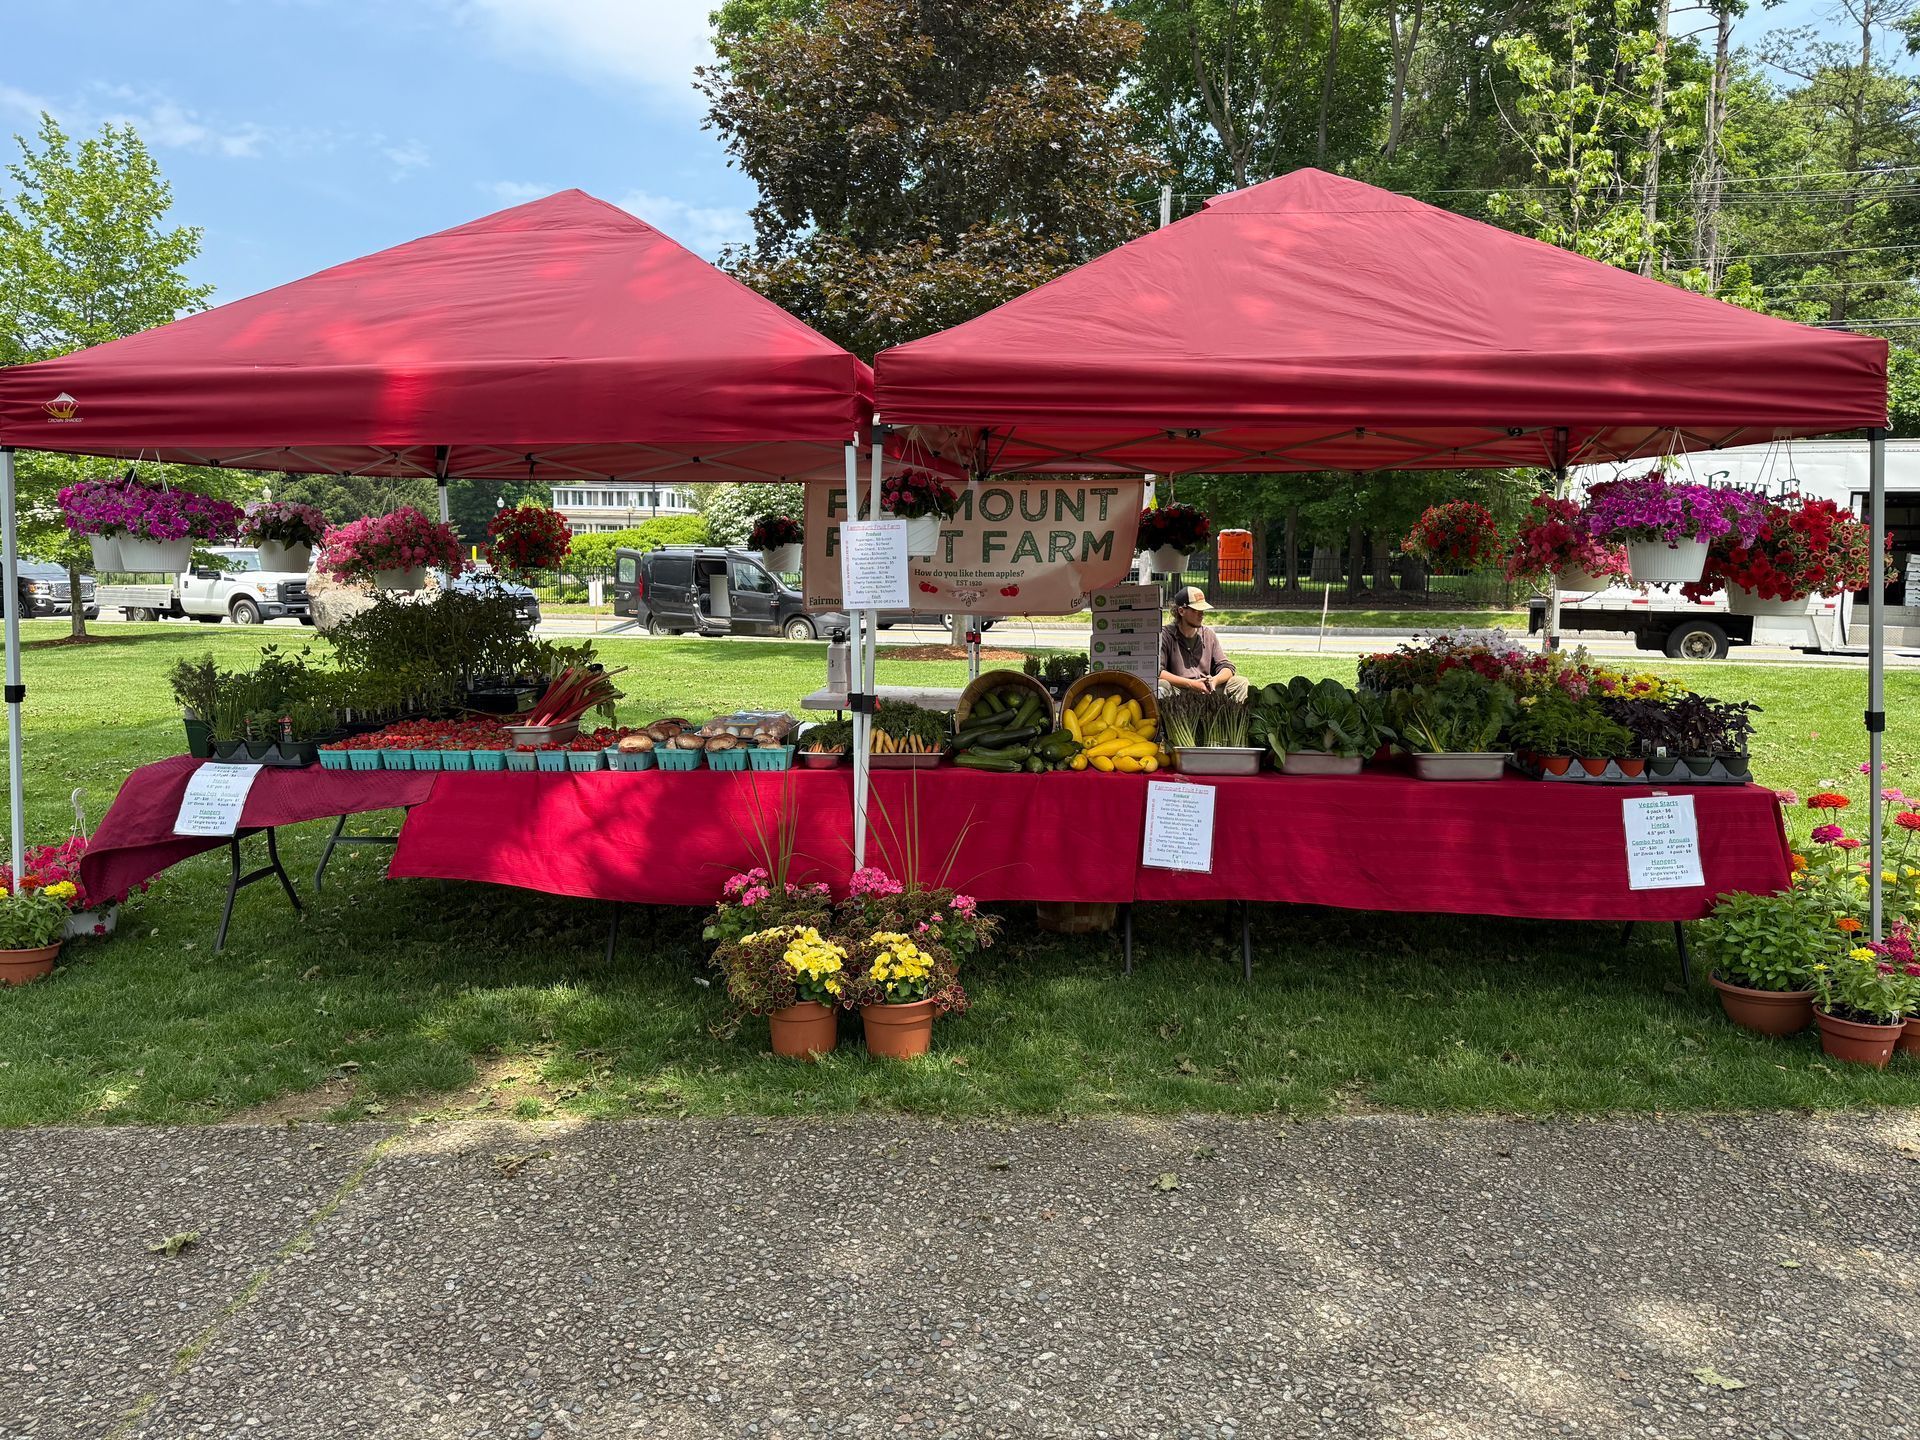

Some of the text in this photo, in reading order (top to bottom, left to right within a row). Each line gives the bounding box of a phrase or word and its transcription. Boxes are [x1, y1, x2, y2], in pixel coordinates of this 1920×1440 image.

[981, 530, 1115, 564] FARM
[914, 568, 1025, 580] How do you like them apples?
